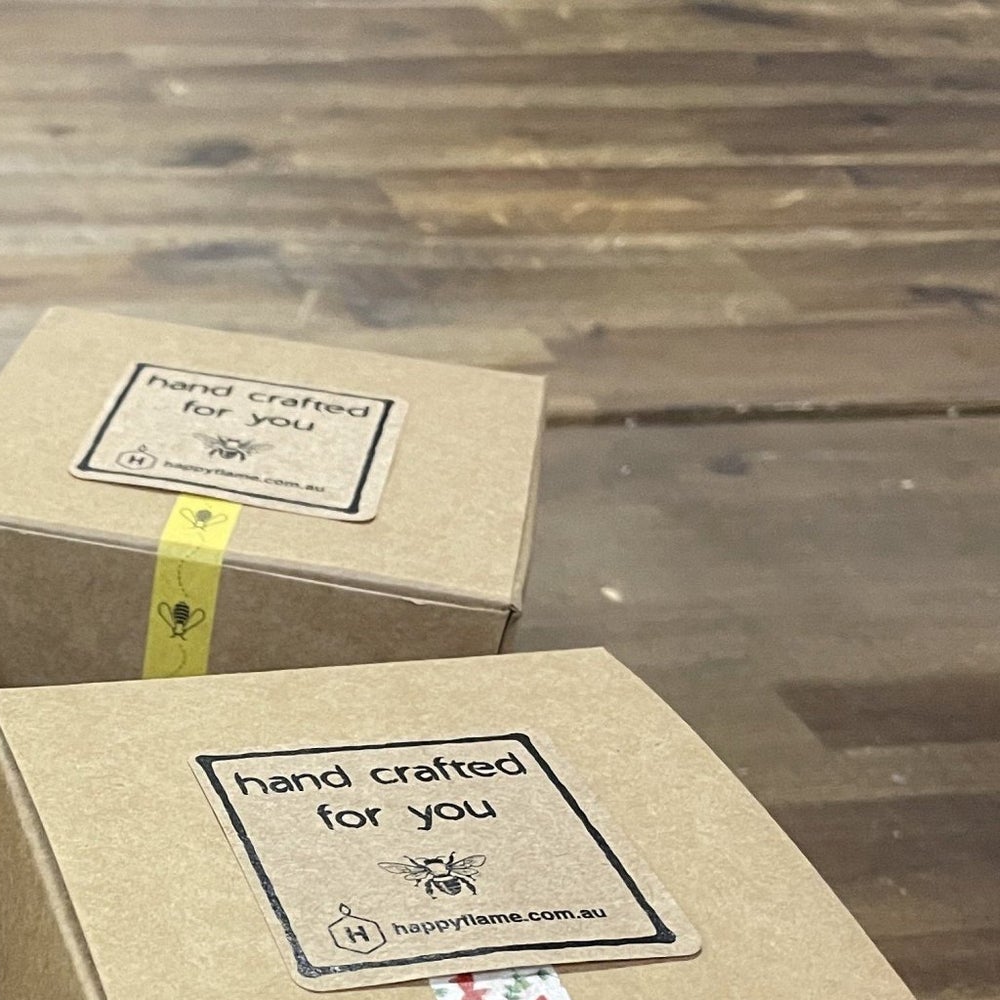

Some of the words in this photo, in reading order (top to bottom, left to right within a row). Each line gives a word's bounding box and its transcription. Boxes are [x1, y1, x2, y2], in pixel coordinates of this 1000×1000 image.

[147, 374, 232, 397] hand
[249, 391, 370, 418] crafted
[183, 400, 233, 418] for
[246, 412, 315, 432] you
[129, 455, 145, 465] H
[163, 460, 326, 493] happyflame.com.au
[235, 764, 351, 796] hand
[370, 751, 527, 787] crafted
[317, 802, 381, 831] for
[408, 798, 497, 831] you
[347, 925, 367, 944] H
[392, 906, 607, 936] happyflame.com.au
